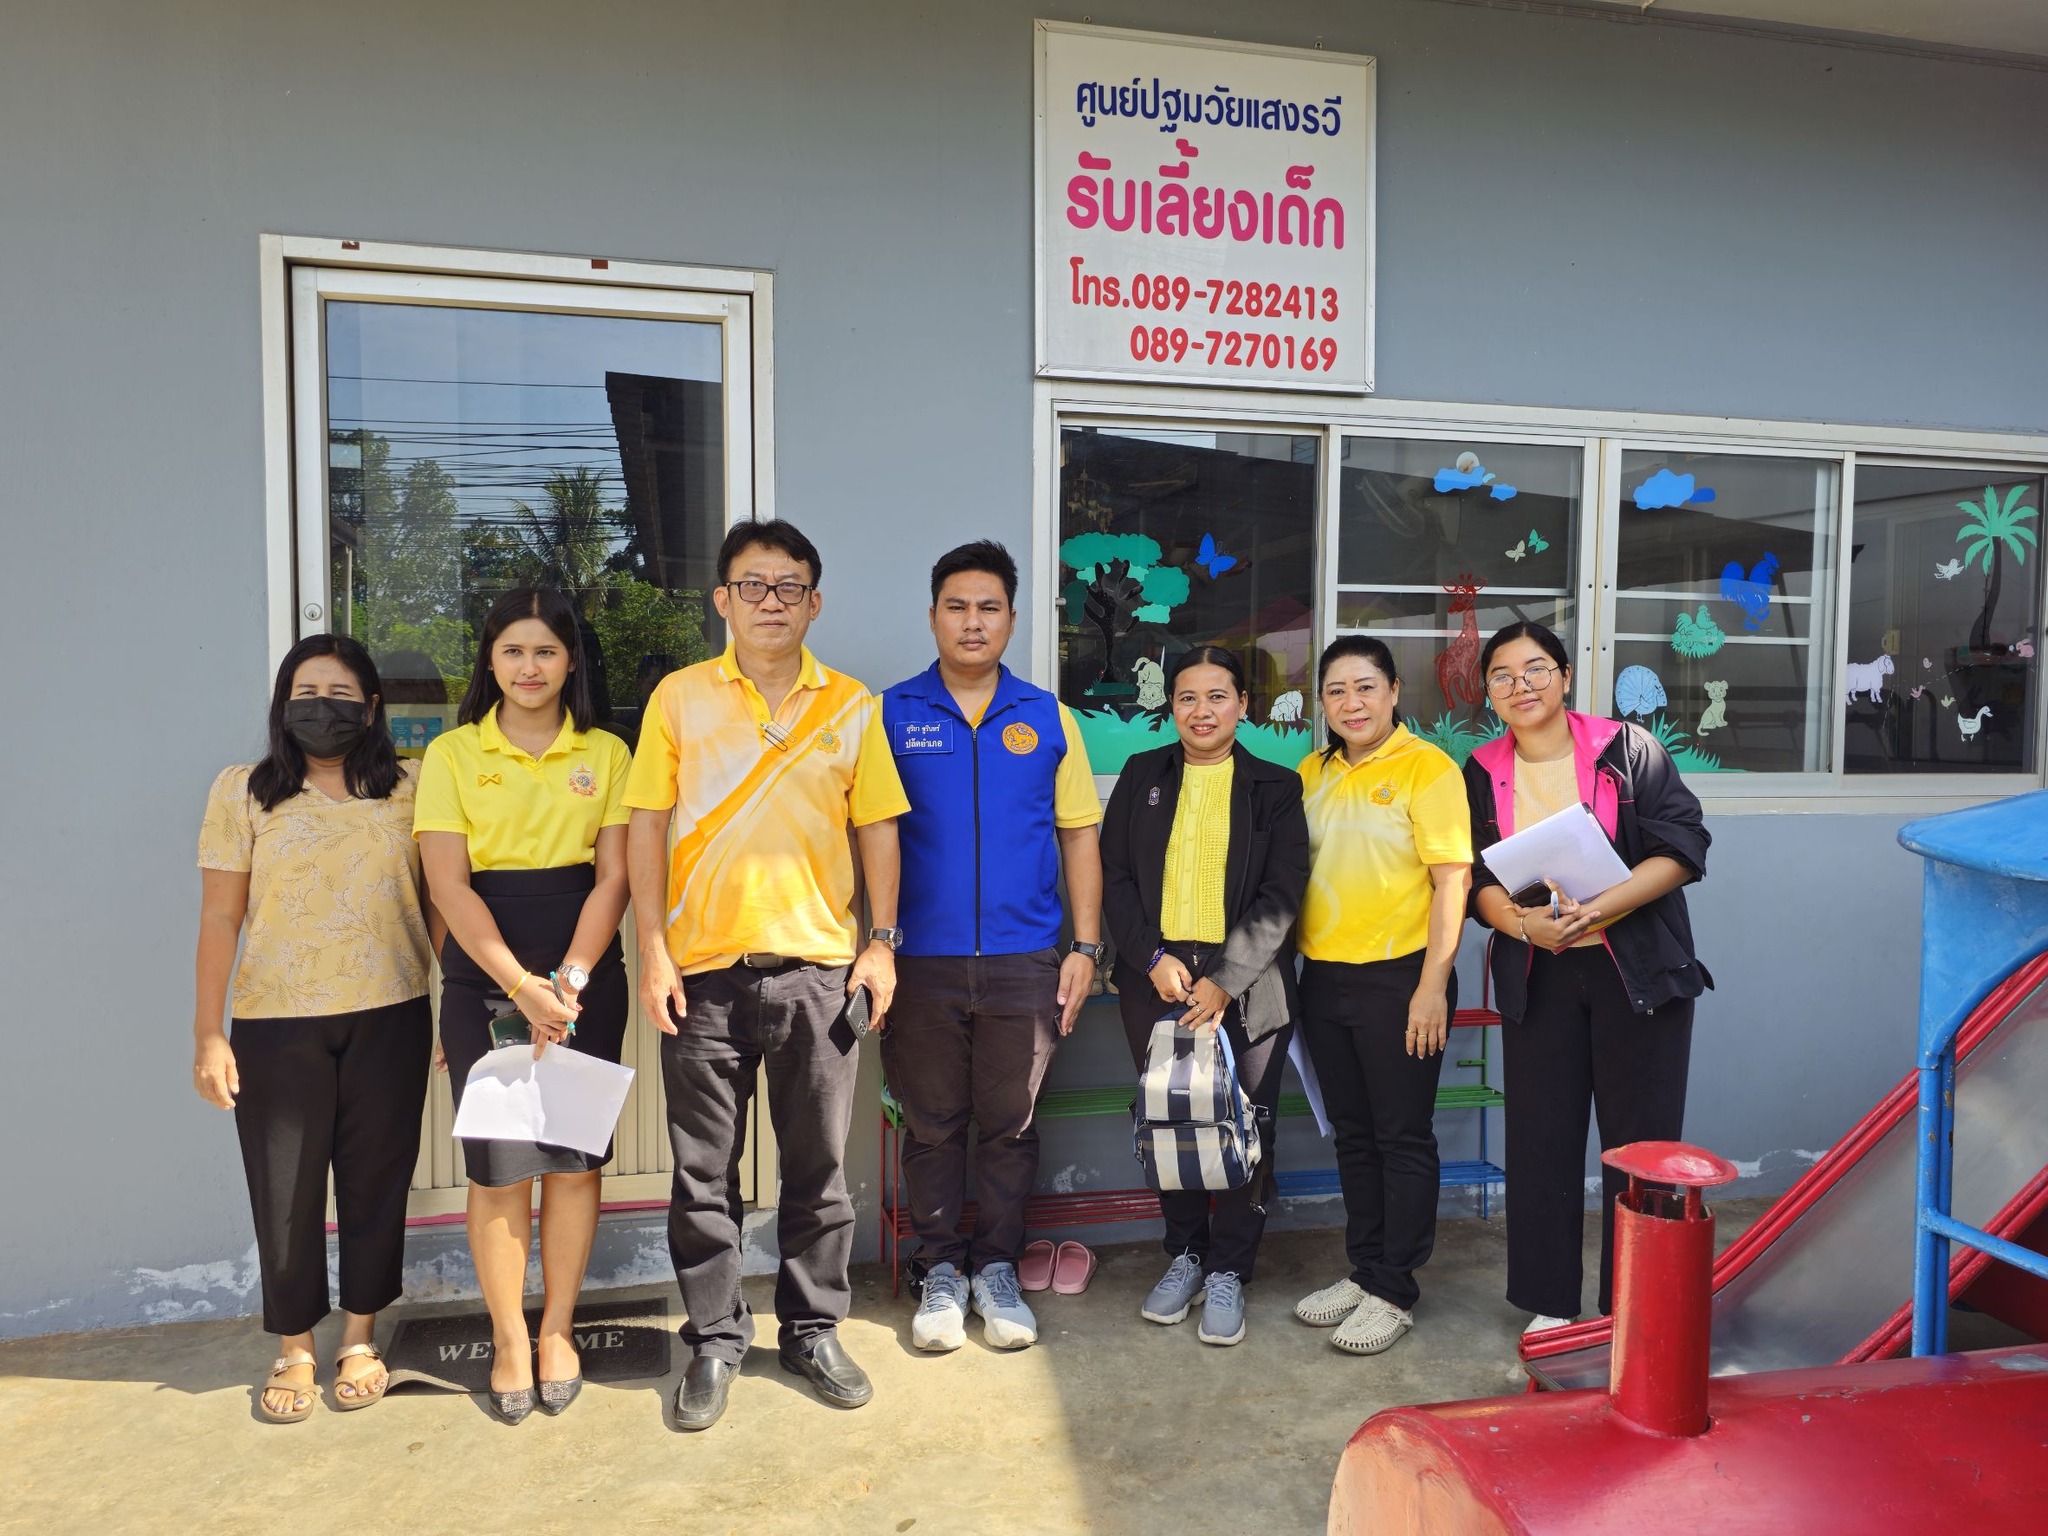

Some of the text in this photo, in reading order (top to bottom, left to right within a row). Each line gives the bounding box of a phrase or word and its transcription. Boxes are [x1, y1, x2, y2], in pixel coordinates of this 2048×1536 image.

[1076, 77, 1342, 137] ศูนย์ปฐมวัยแสงรวี
[1066, 138, 1345, 250] รับเลี้ยงเด็ก
[1069, 256, 1340, 322] โทร.089-7282413
[1130, 325, 1338, 372] 089-7270169
[438, 1330, 625, 1362] WEME
